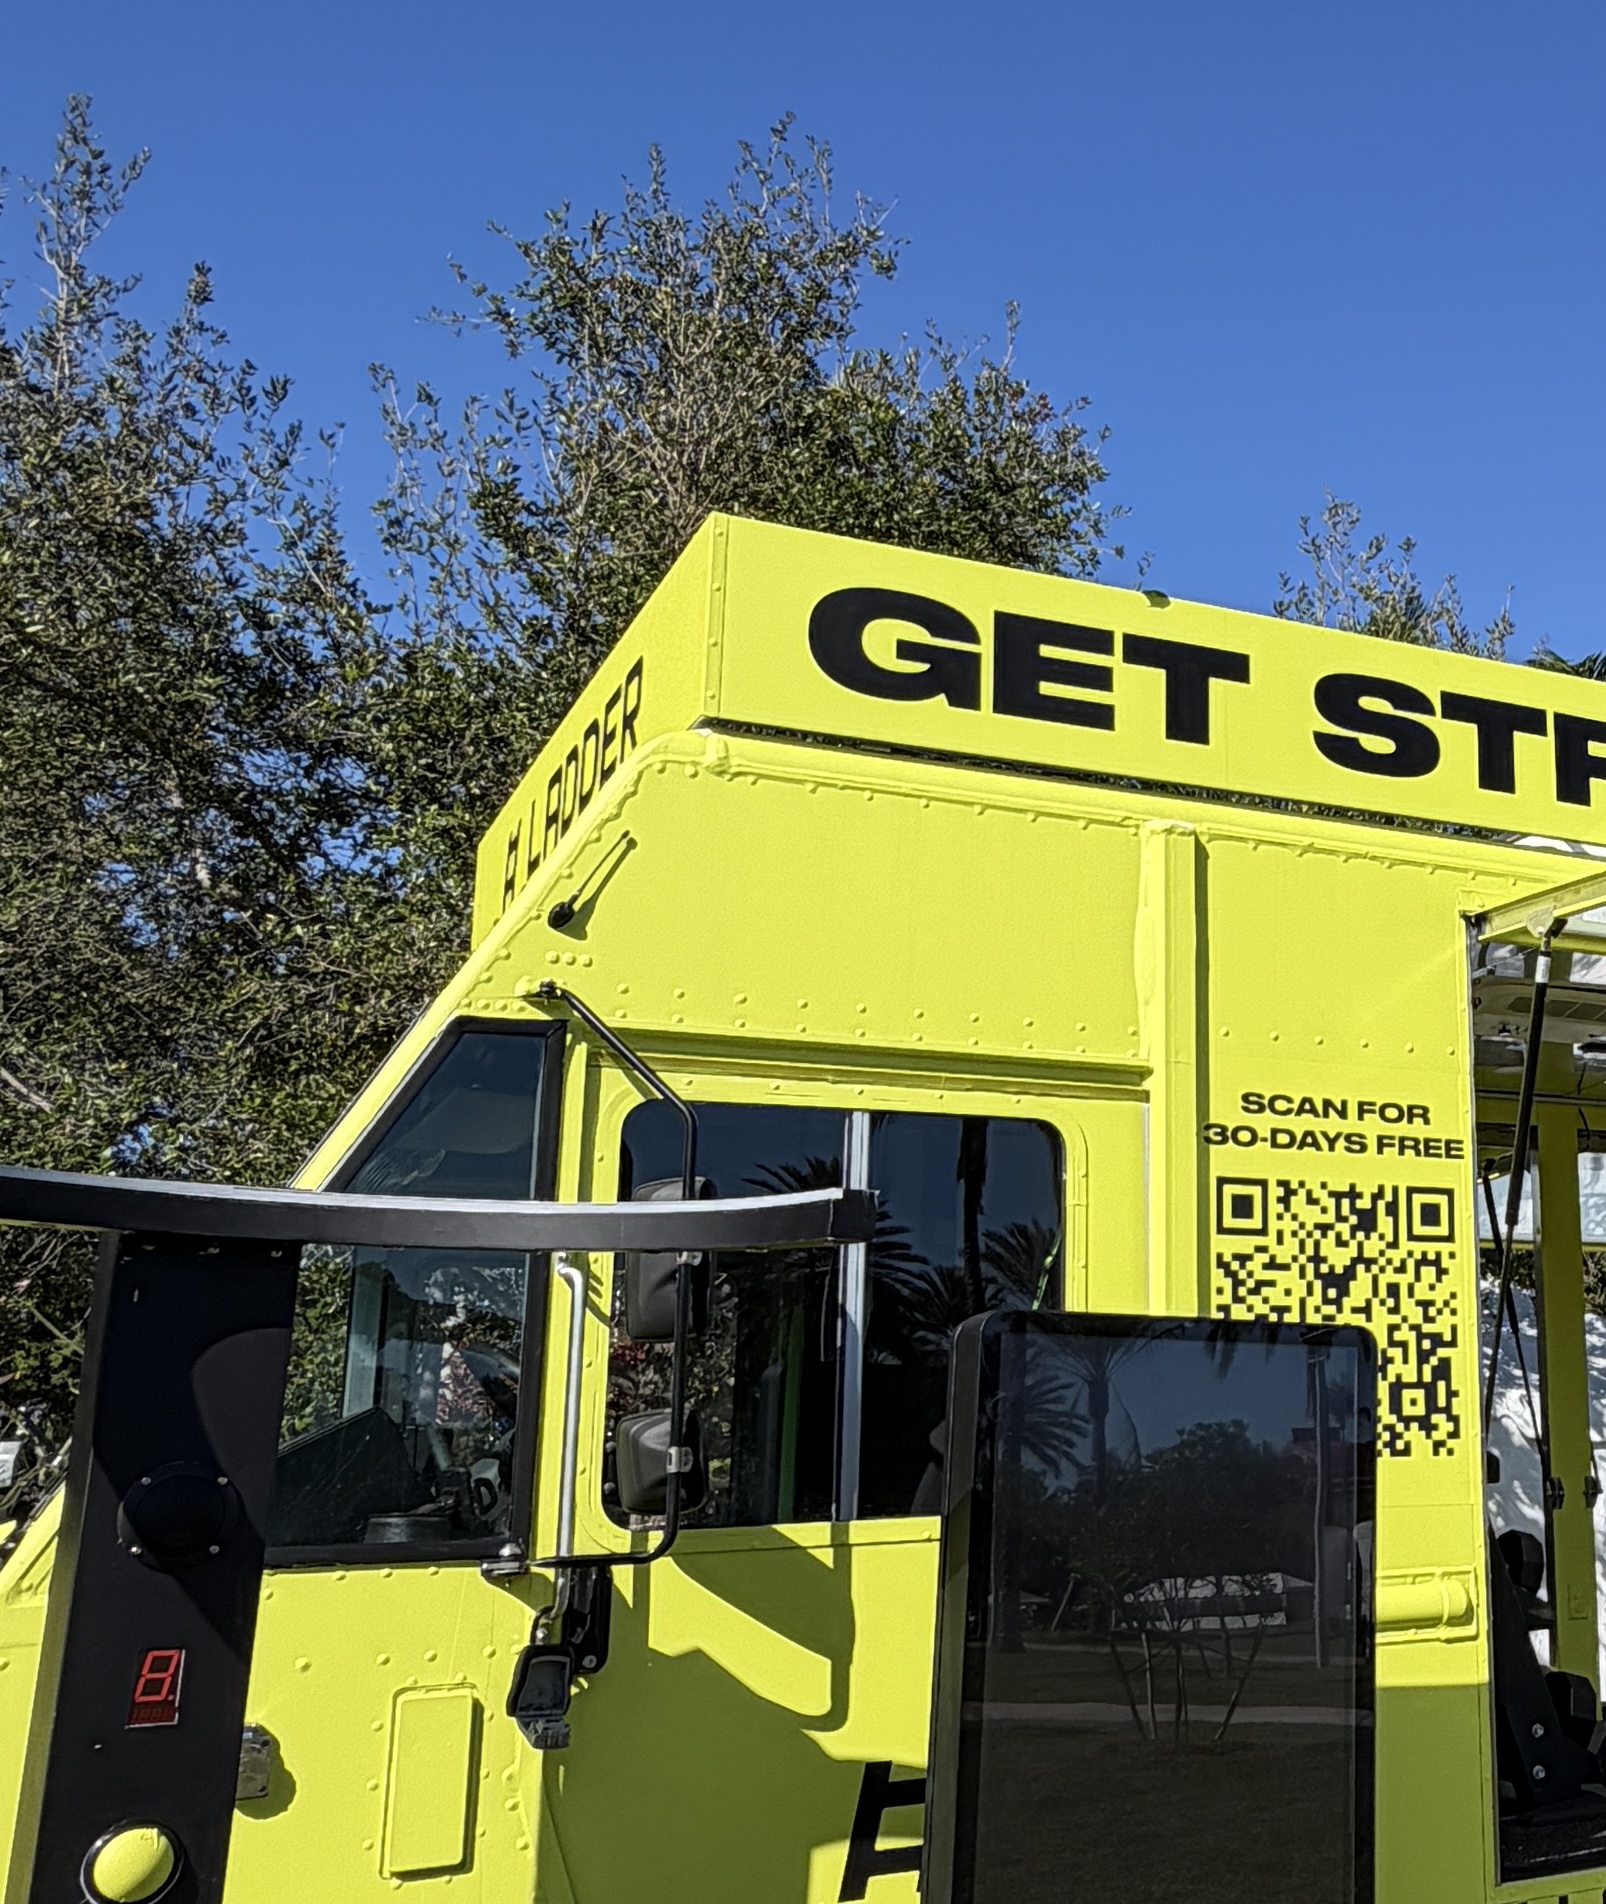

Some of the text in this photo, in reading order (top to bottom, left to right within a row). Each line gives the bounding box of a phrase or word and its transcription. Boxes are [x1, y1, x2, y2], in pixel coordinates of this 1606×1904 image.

[808, 587, 1251, 746] GET
[527, 655, 643, 882] LADDER
[1203, 1123, 1465, 1159] 30-DAYS FREE
[1240, 1092, 1431, 1125] SCAN FOR
